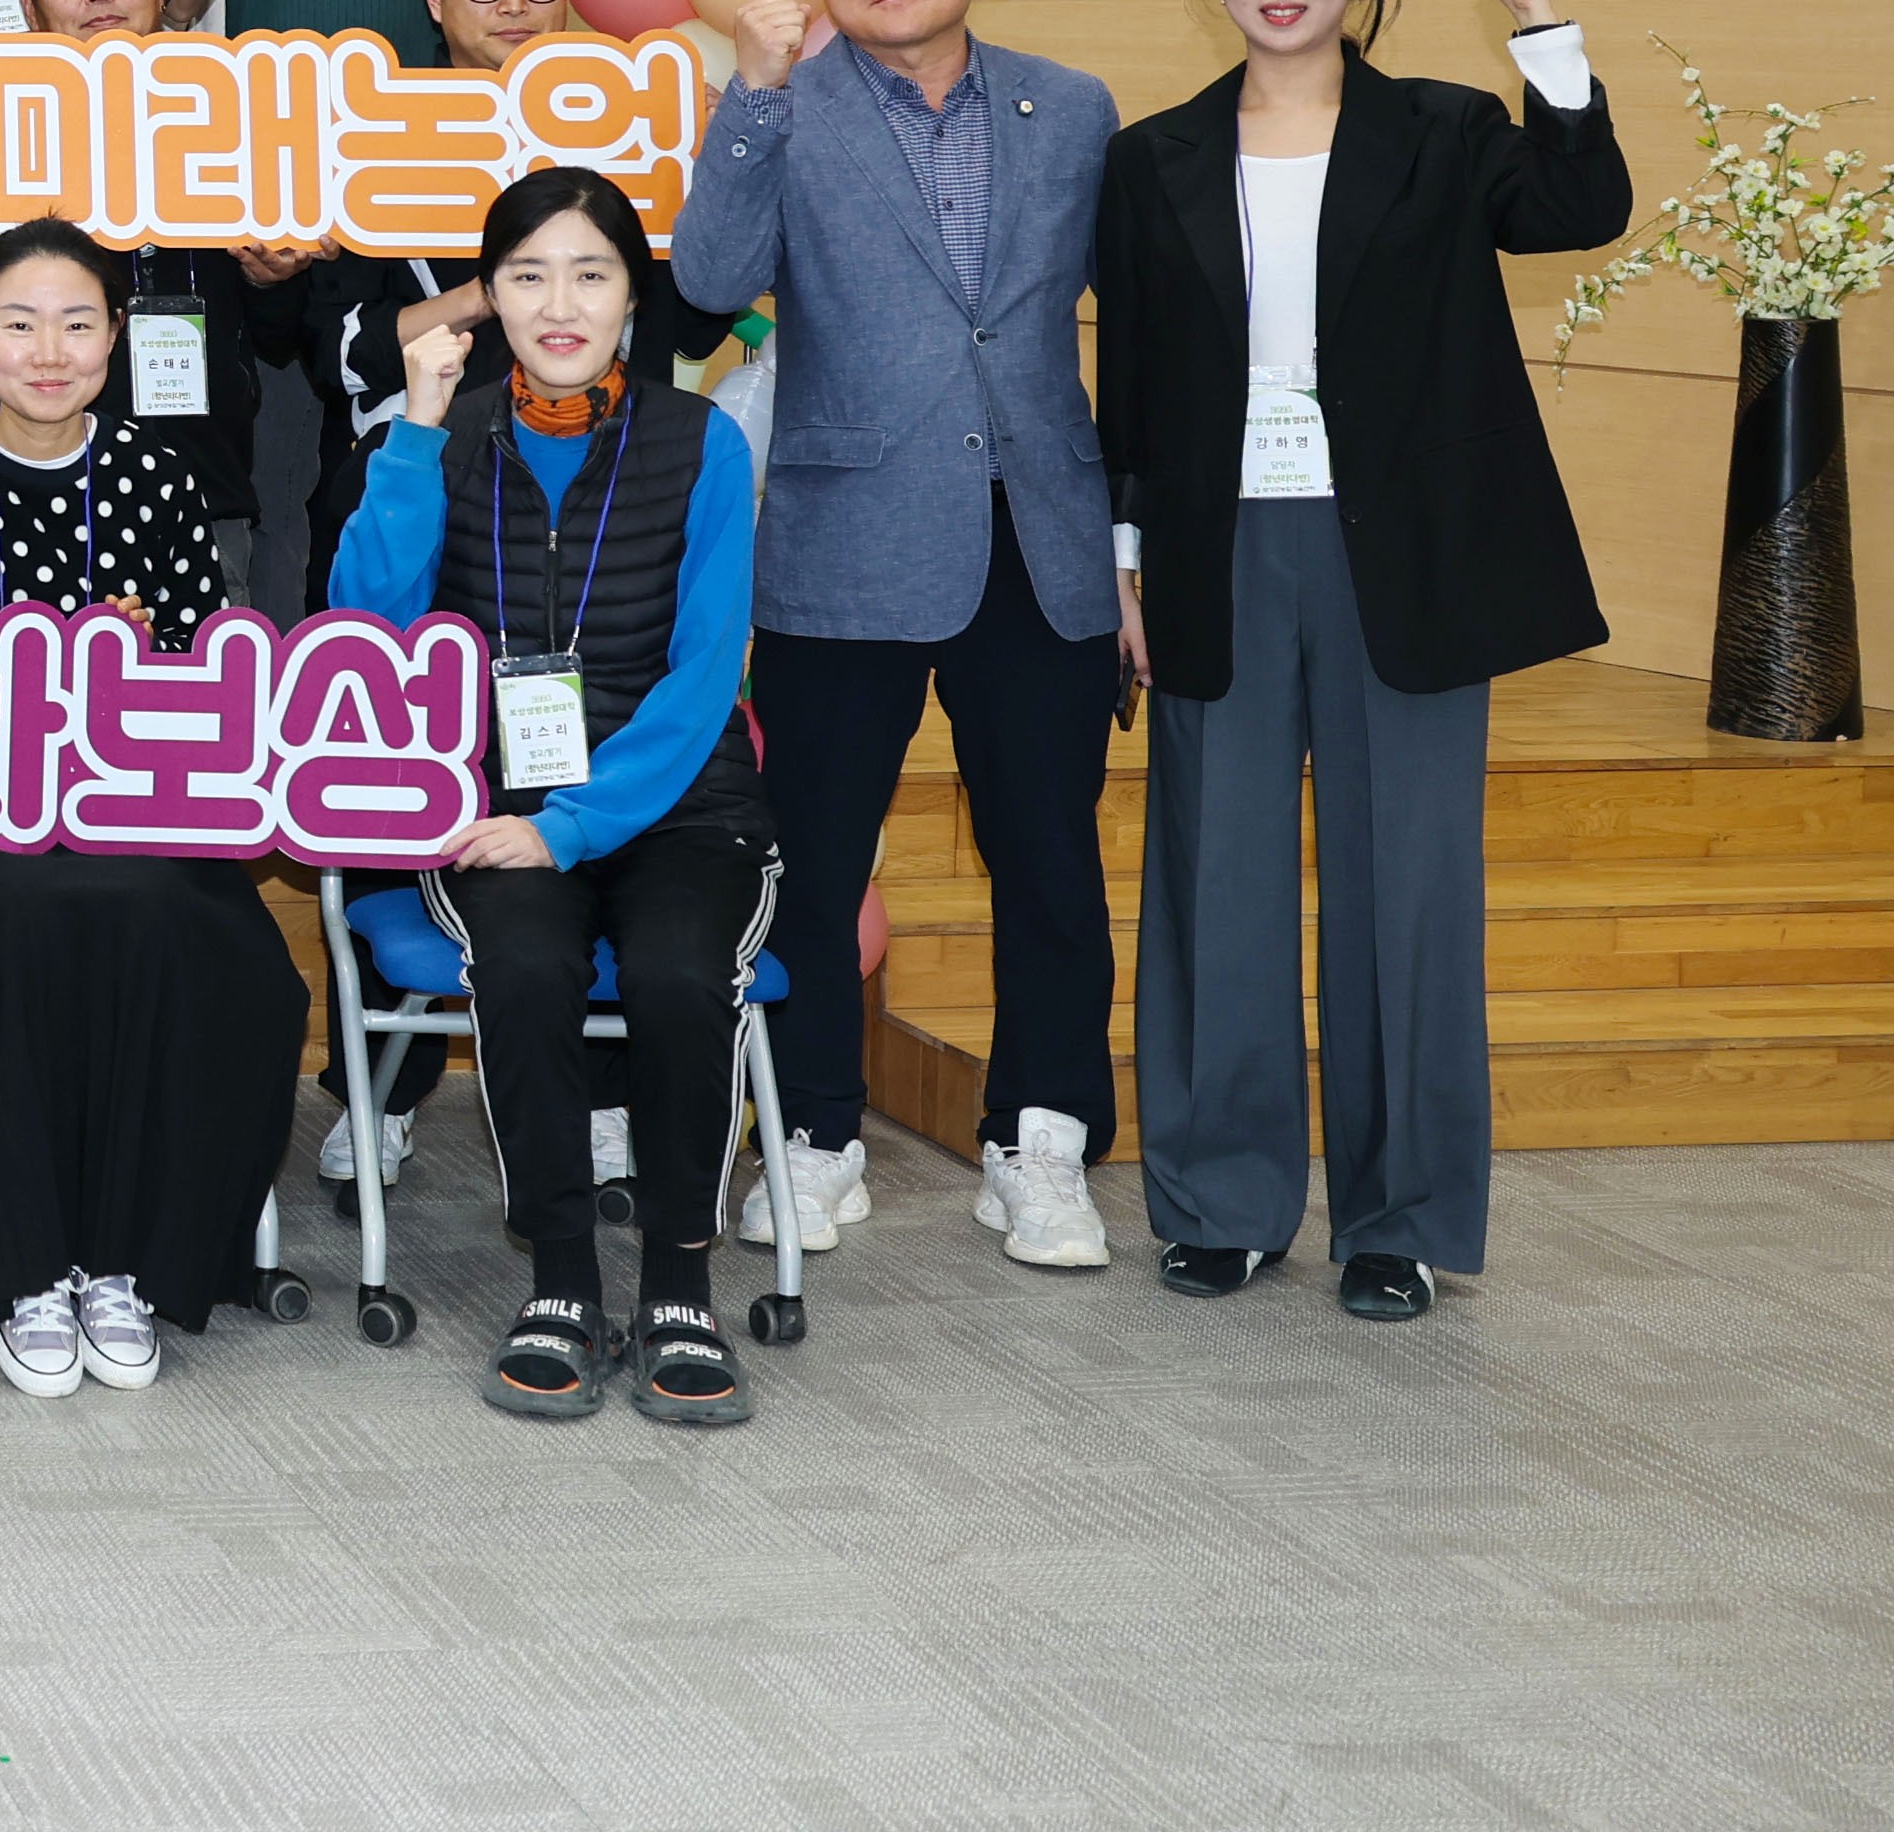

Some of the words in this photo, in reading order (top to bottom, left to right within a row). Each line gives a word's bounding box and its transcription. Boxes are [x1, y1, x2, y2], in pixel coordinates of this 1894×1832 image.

[148, 358, 190, 369] 손태섭
[1255, 435, 1309, 450] 강하영
[520, 723, 568, 740] 김스리
